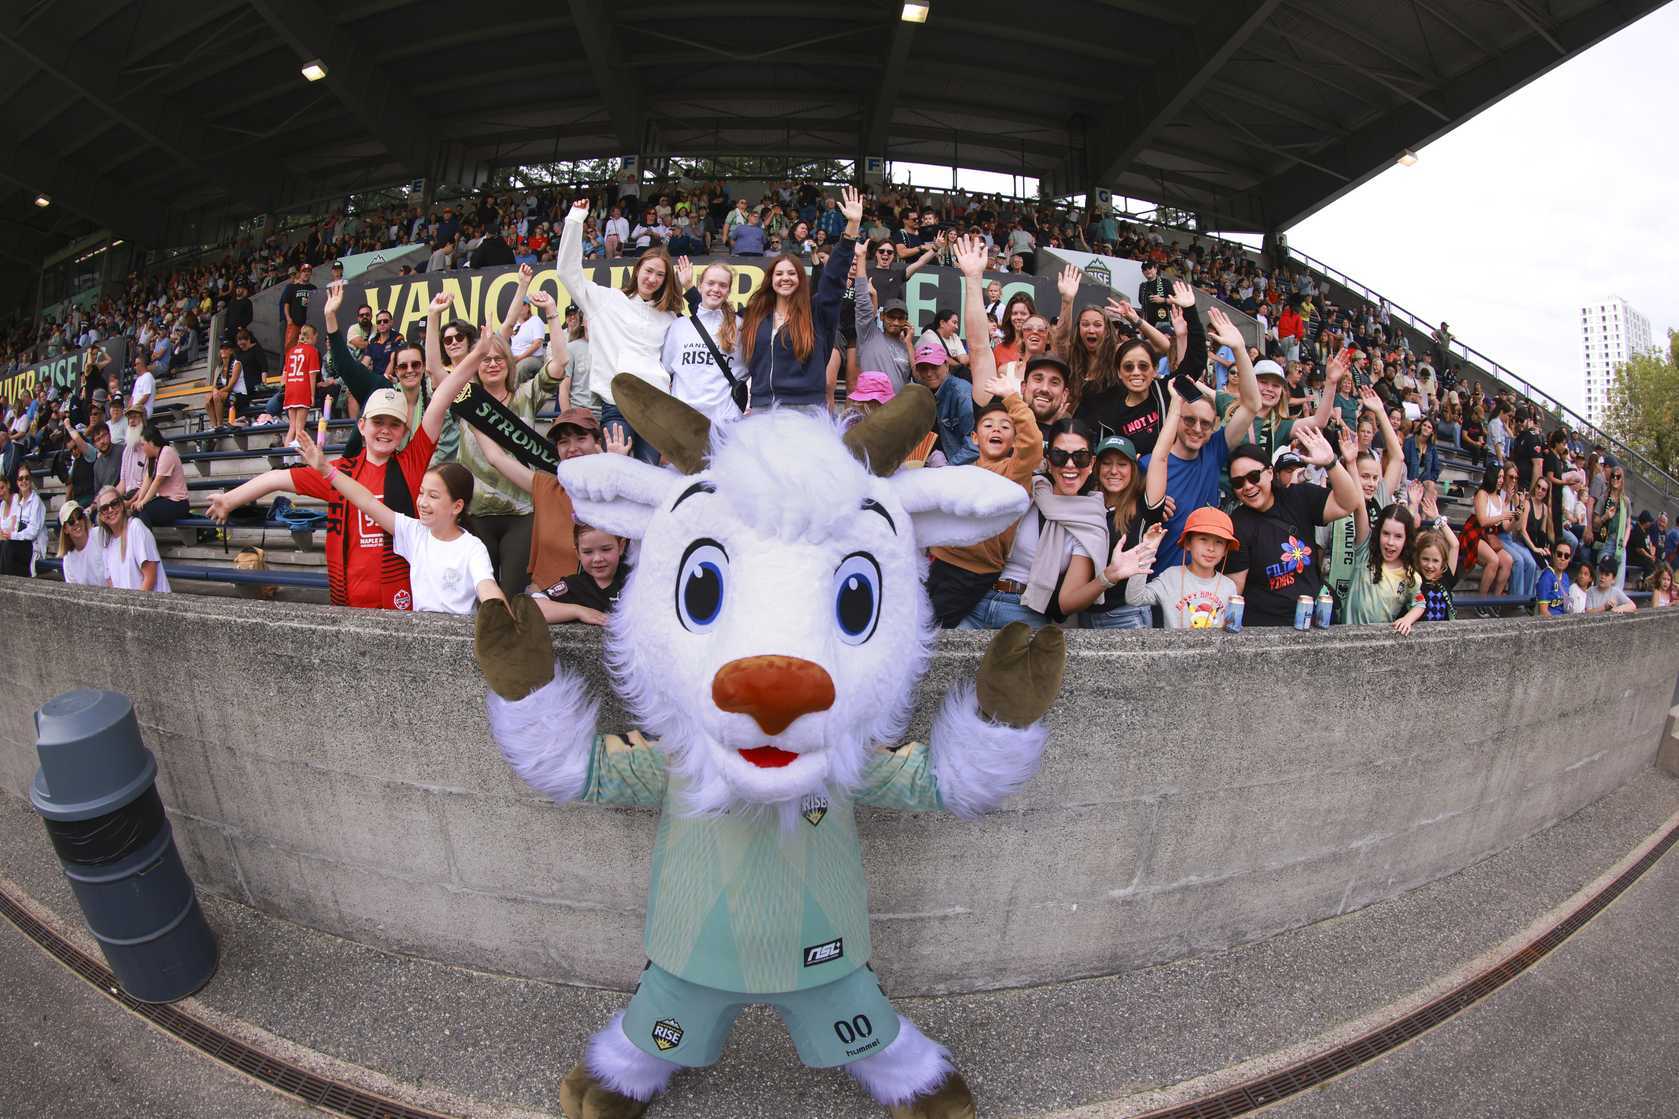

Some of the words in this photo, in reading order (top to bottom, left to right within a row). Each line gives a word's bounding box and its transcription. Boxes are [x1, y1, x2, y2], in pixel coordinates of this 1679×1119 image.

[868, 159, 881, 171] F
[413, 178, 422, 192] E
[1098, 190, 1109, 203] G
[288, 354, 304, 376] 32
[682, 351, 714, 366] RISE
[1127, 416, 1147, 432] NOT
[1343, 551, 1354, 565] FC
[654, 1025, 681, 1044] RISE
[834, 1014, 872, 1044] 00
[846, 1038, 880, 1057] hummel
